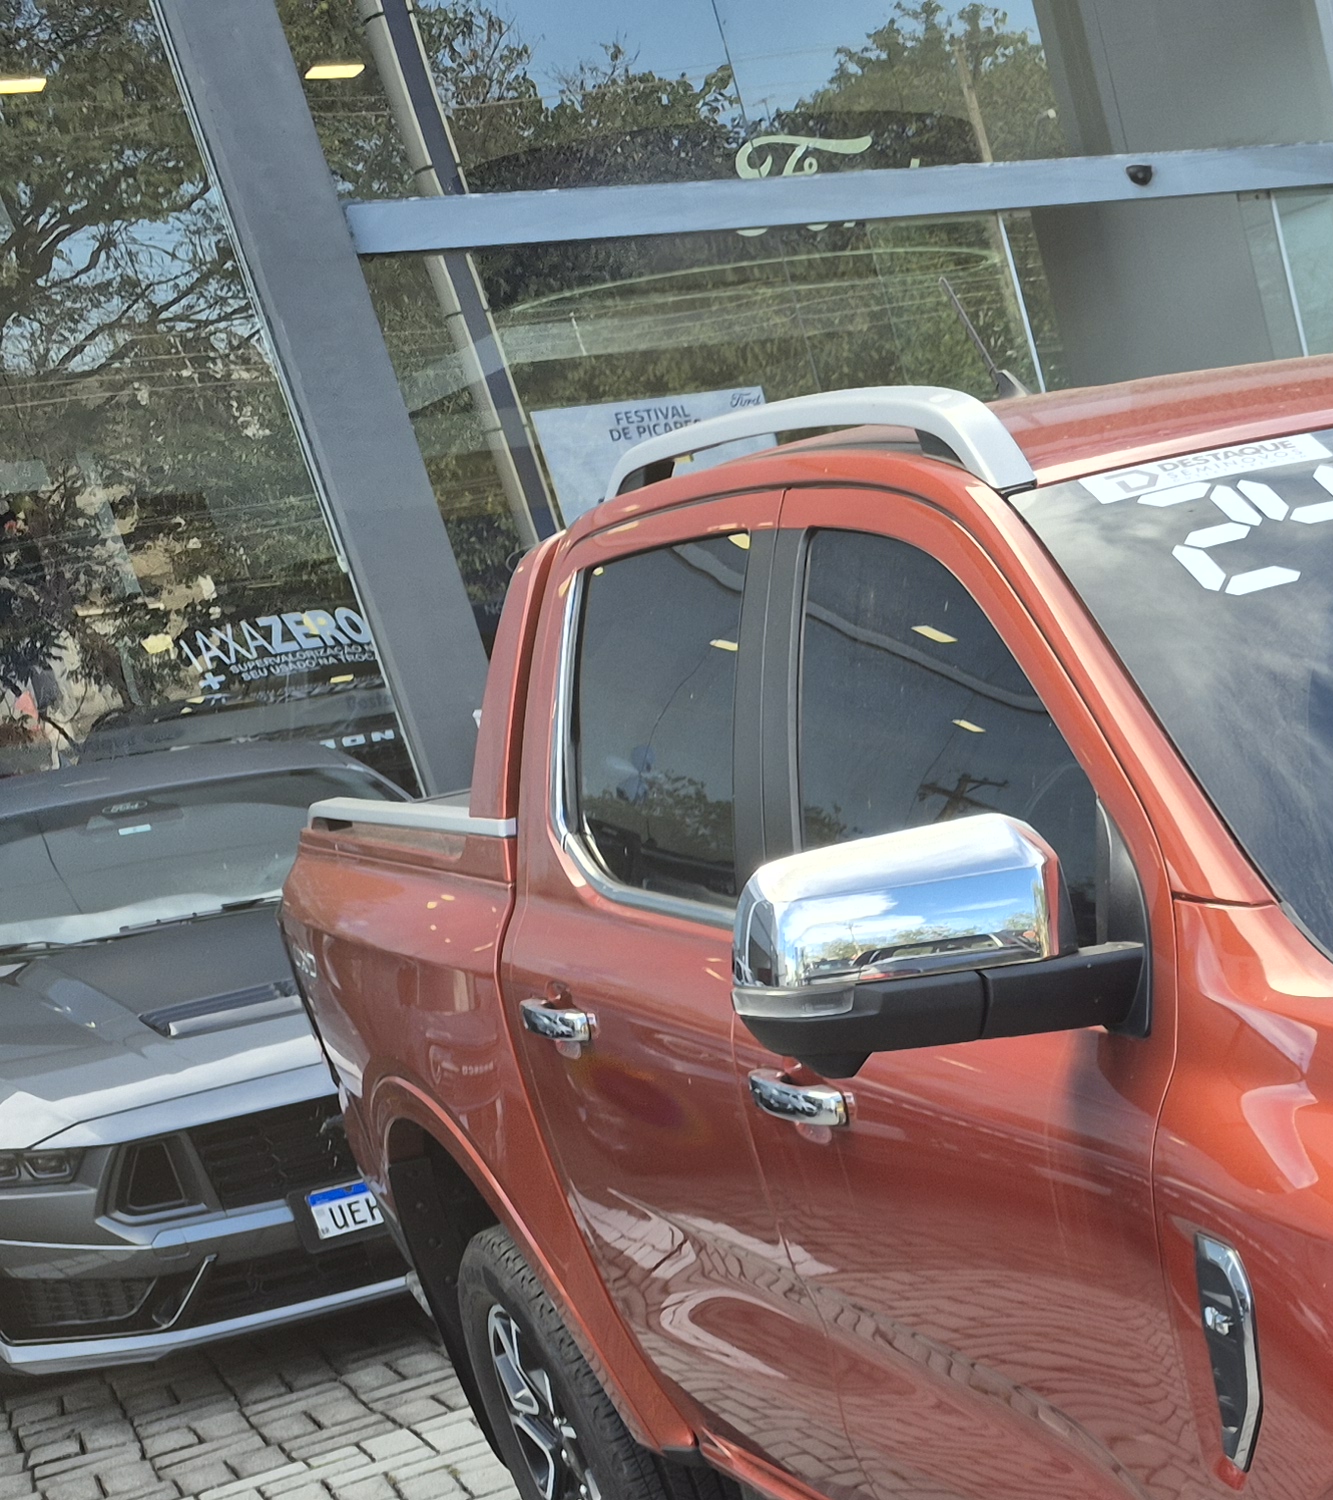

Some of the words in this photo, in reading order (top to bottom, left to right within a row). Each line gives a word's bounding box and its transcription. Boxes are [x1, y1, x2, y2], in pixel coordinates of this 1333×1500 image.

[730, 393, 762, 408] Ford
[614, 404, 691, 426] FESTIVAL
[609, 427, 633, 442] DE
[636, 419, 702, 438] PICAP
[1157, 440, 1297, 473] DESTAQUE
[1166, 448, 1303, 480] SEMINOVOS
[242, 667, 268, 682] SEU
[270, 659, 317, 676] USADO
[318, 655, 338, 667] NA
[338, 651, 378, 664] TROC
